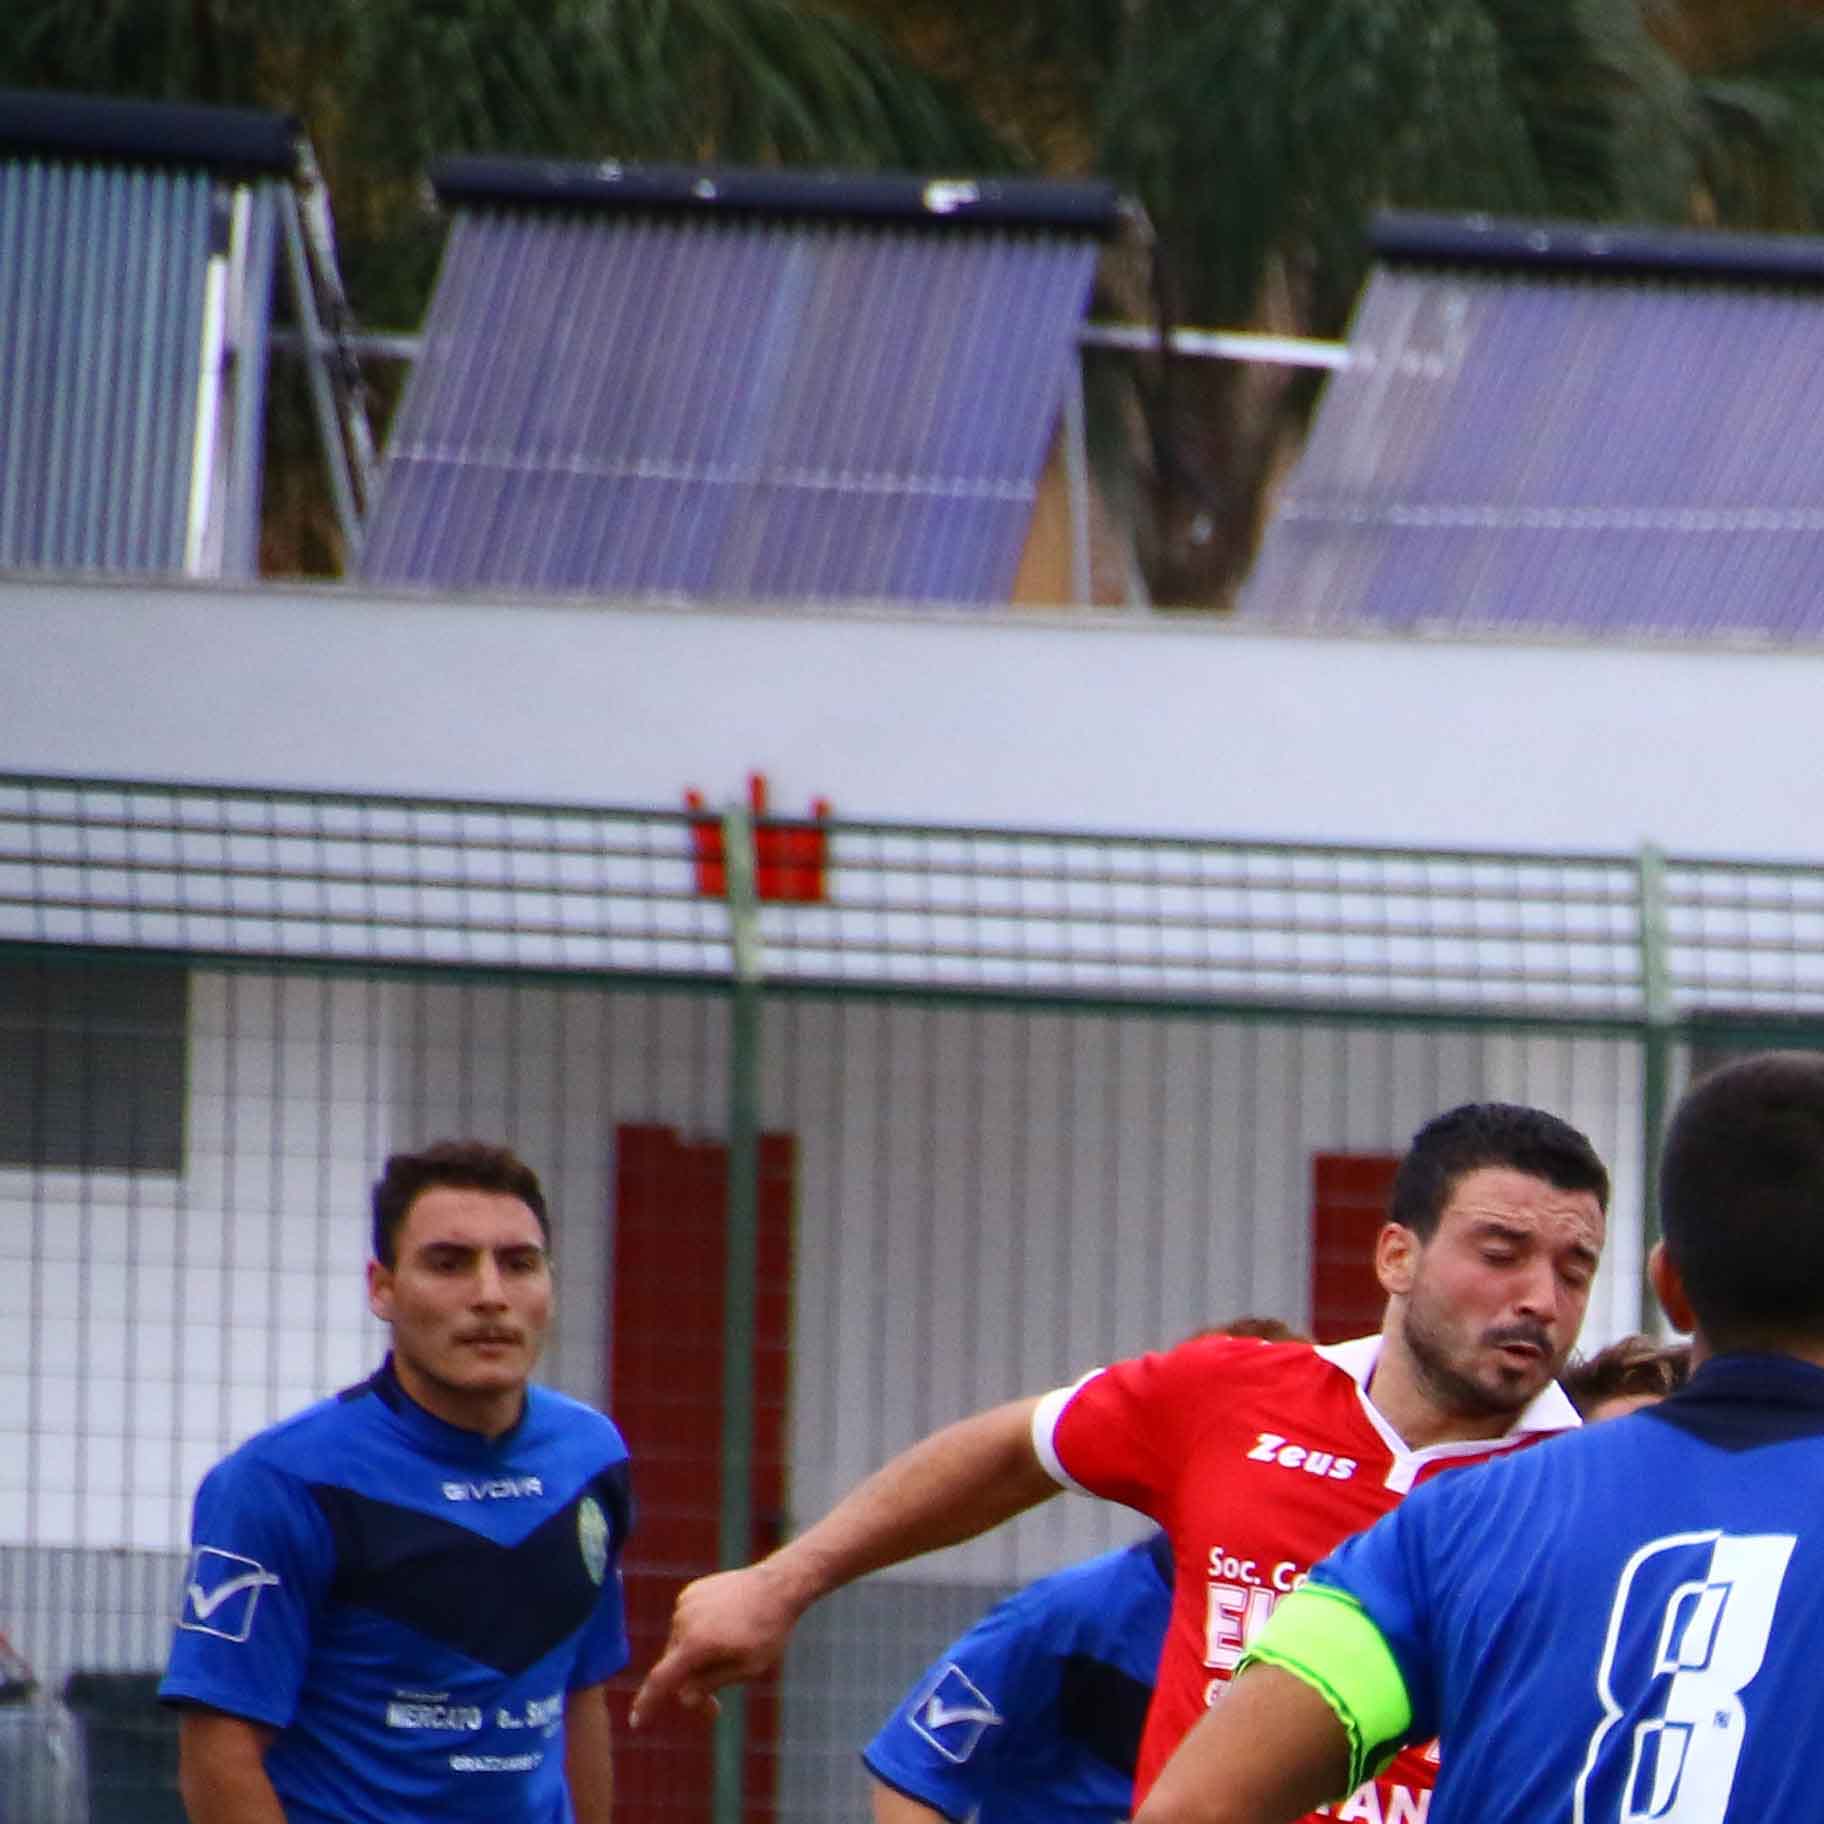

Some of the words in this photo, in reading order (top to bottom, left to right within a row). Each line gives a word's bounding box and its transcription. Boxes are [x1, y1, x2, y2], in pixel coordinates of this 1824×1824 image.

[1246, 1432, 1358, 1481] Zeus
[1207, 1546, 1263, 1585] Soc.
[1272, 1561, 1309, 1591] Co
